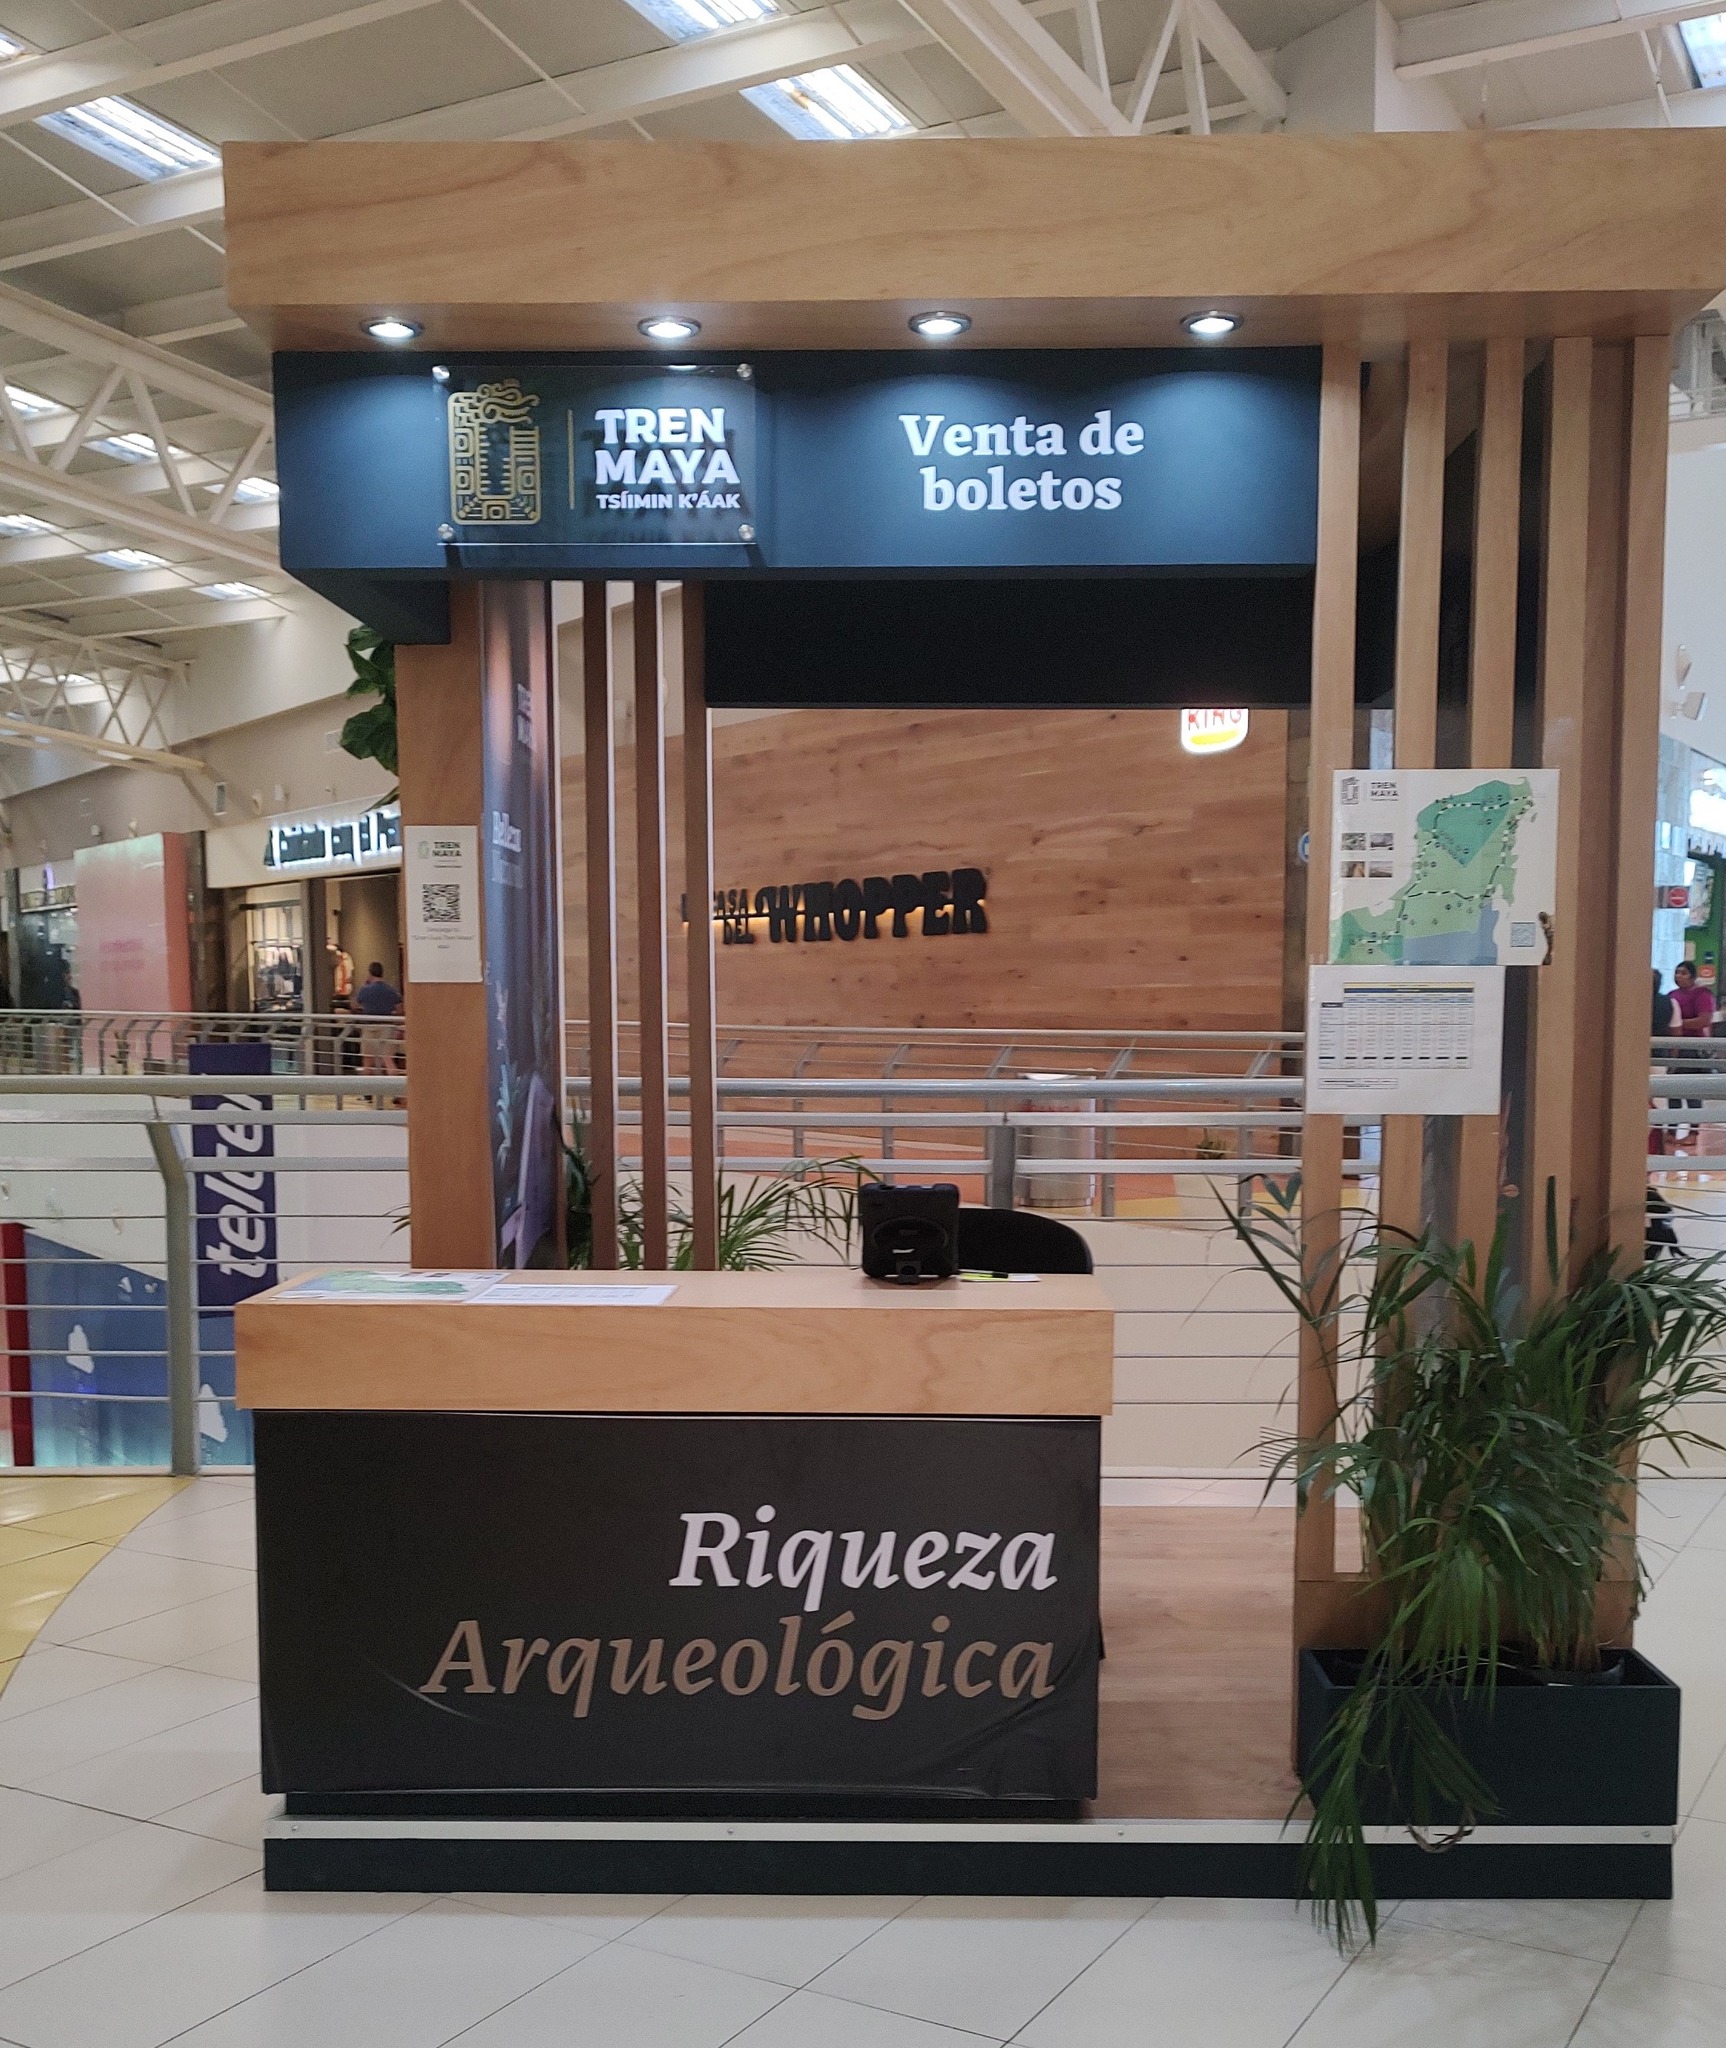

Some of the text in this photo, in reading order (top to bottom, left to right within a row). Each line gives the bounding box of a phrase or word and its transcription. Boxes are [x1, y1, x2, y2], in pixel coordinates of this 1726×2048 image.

[594, 408, 726, 444] TREN
[899, 410, 1145, 456] Venta de
[594, 449, 741, 484] MAYA
[919, 465, 1123, 511] boletos
[595, 490, 673, 509] TSÍIMIN
[755, 868, 987, 943] WHOPPER
[668, 1504, 1059, 1612] Riqueza
[418, 1609, 1056, 1721] Arqueológica
